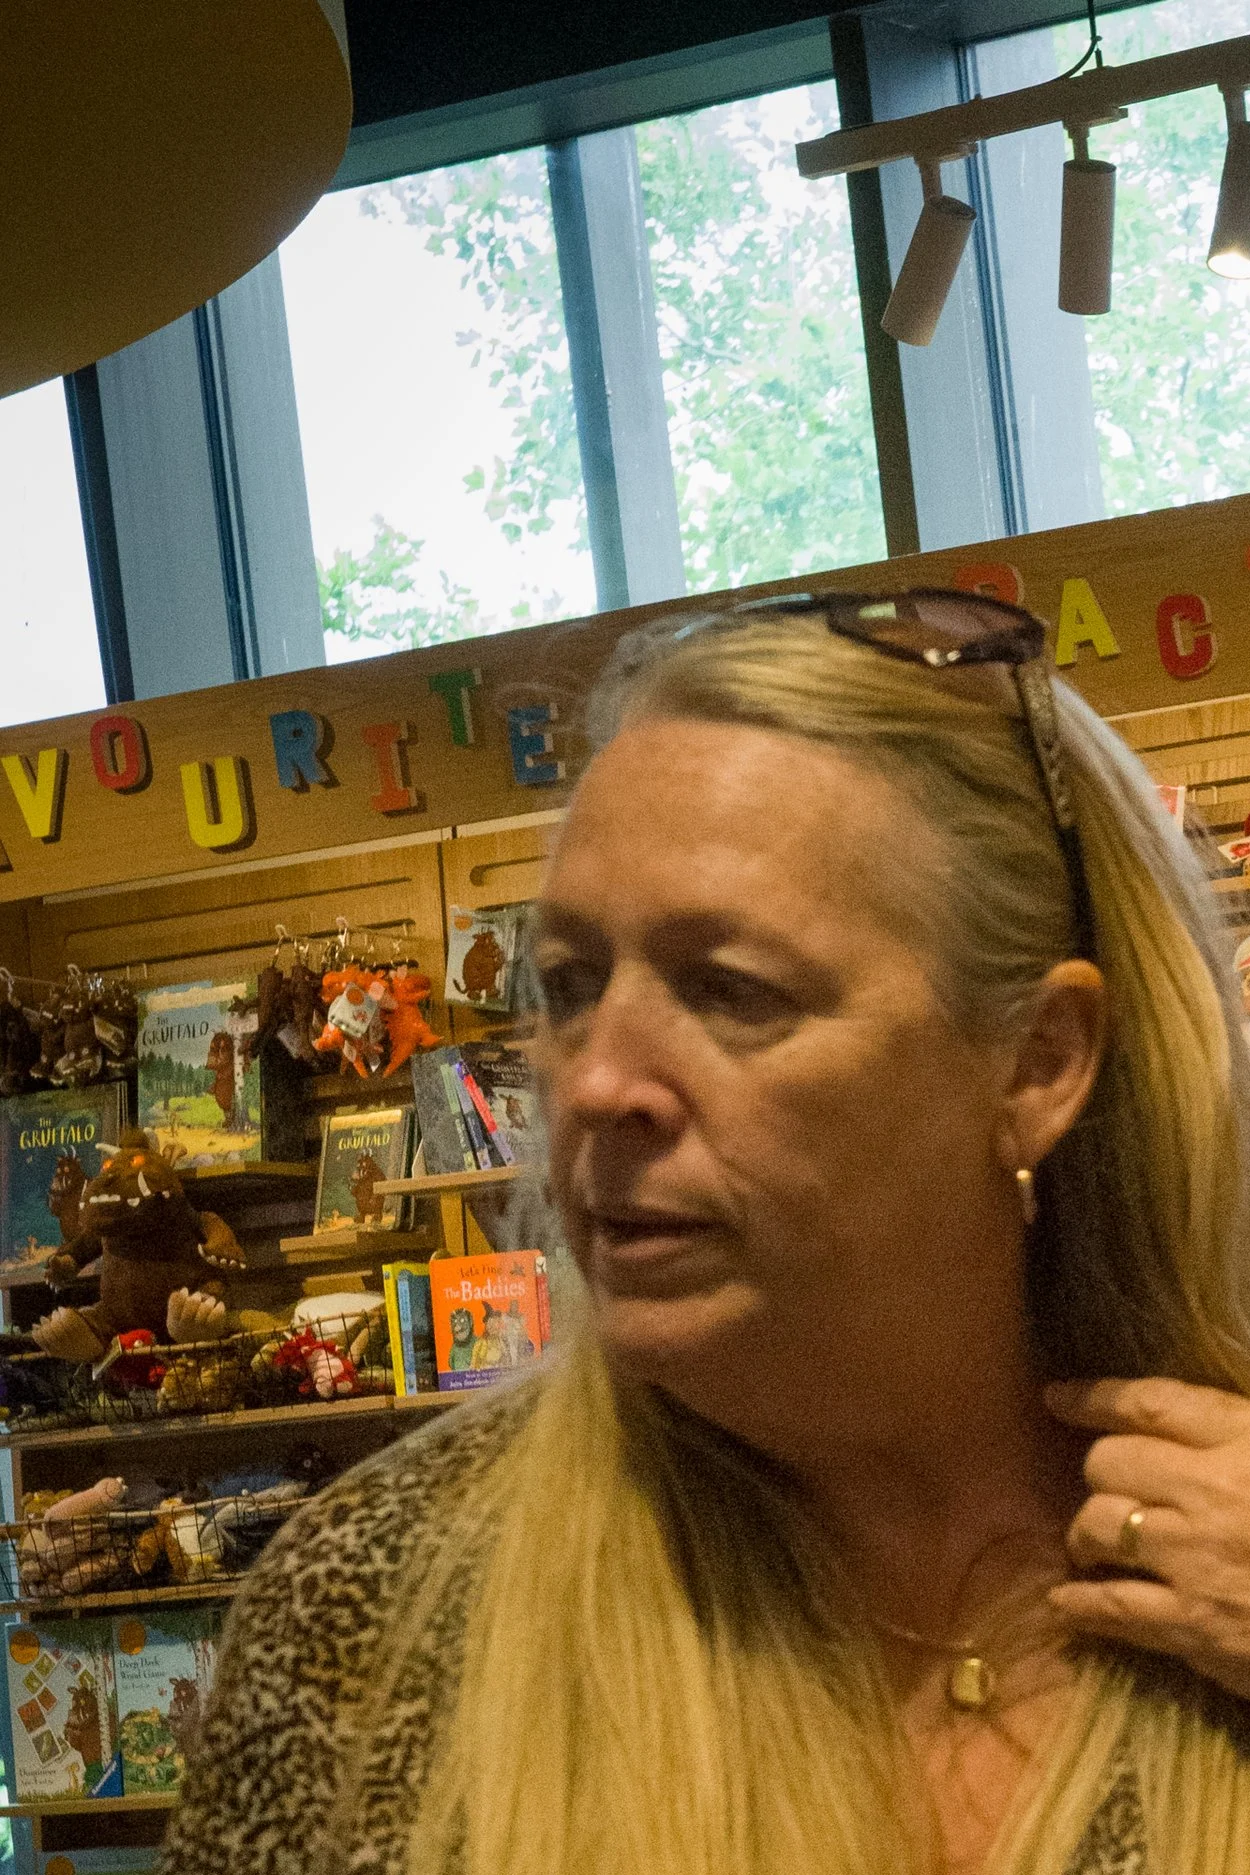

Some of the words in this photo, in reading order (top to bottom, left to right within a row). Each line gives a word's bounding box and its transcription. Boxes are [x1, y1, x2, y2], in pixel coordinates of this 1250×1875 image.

[142, 1021, 209, 1046] GRUFFALO
[39, 1117, 52, 1127] THE
[19, 1123, 95, 1150] GRUFFALO
[339, 1133, 390, 1150] GRUFFALO
[460, 1267, 480, 1278] Let's
[443, 1287, 459, 1299] The
[461, 1276, 526, 1302] Baddies
[119, 1658, 138, 1669] Deep
[141, 1656, 160, 1667] Dark
